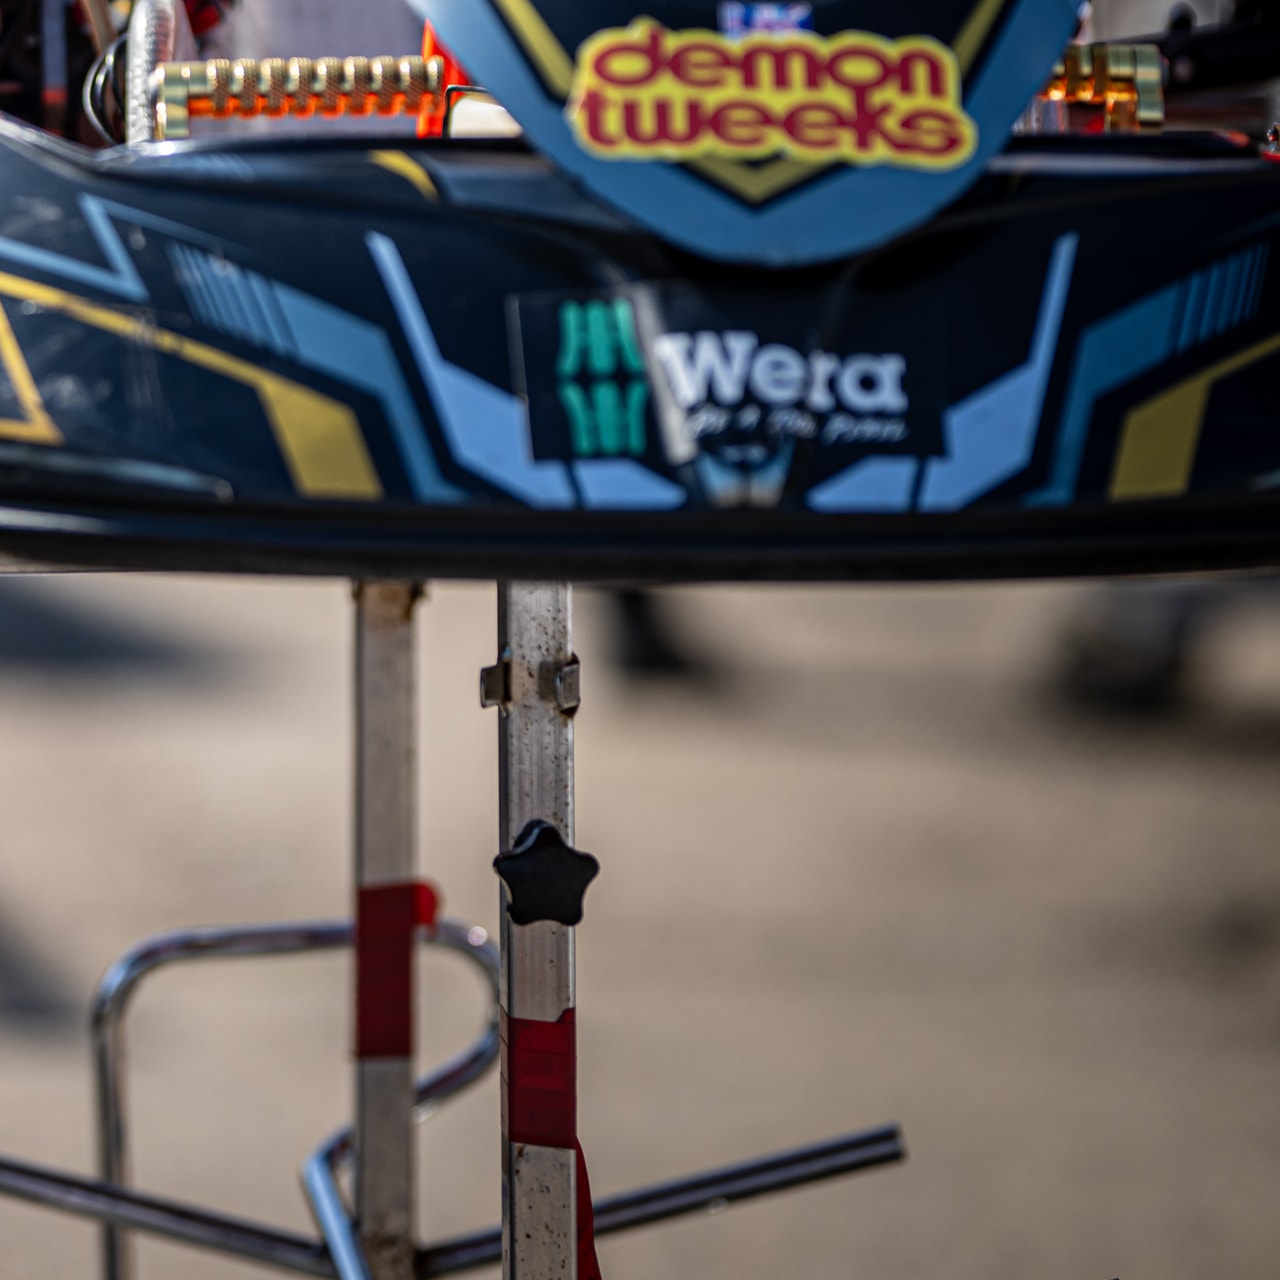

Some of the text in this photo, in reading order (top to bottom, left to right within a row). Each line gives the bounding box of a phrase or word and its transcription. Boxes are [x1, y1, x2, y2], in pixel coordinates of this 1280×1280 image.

[592, 24, 945, 100] demon
[580, 81, 965, 158] tweeks
[653, 330, 908, 412] Wera
